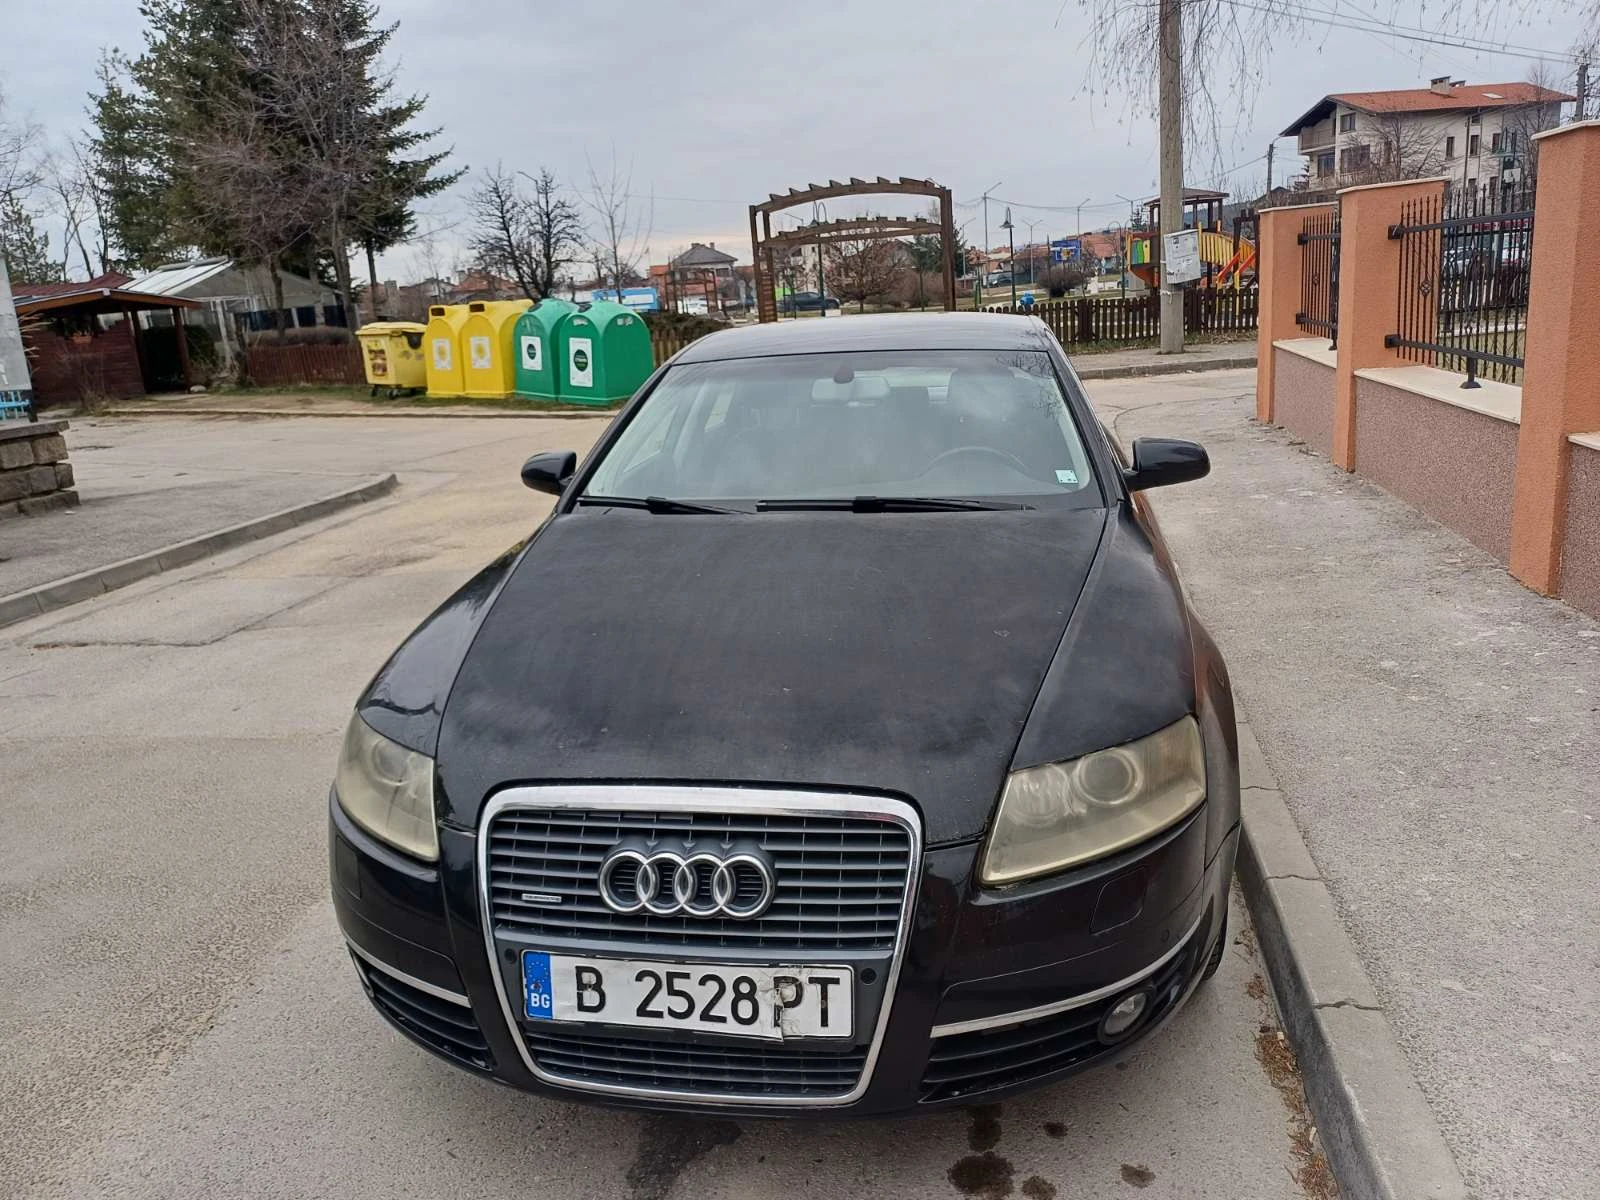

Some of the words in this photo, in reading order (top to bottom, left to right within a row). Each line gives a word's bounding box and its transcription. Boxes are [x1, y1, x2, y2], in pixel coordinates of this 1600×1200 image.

[531, 992, 550, 1009] BG
[575, 965, 606, 1013] B
[635, 969, 760, 1026] 2528
[773, 976, 840, 1027] PT
